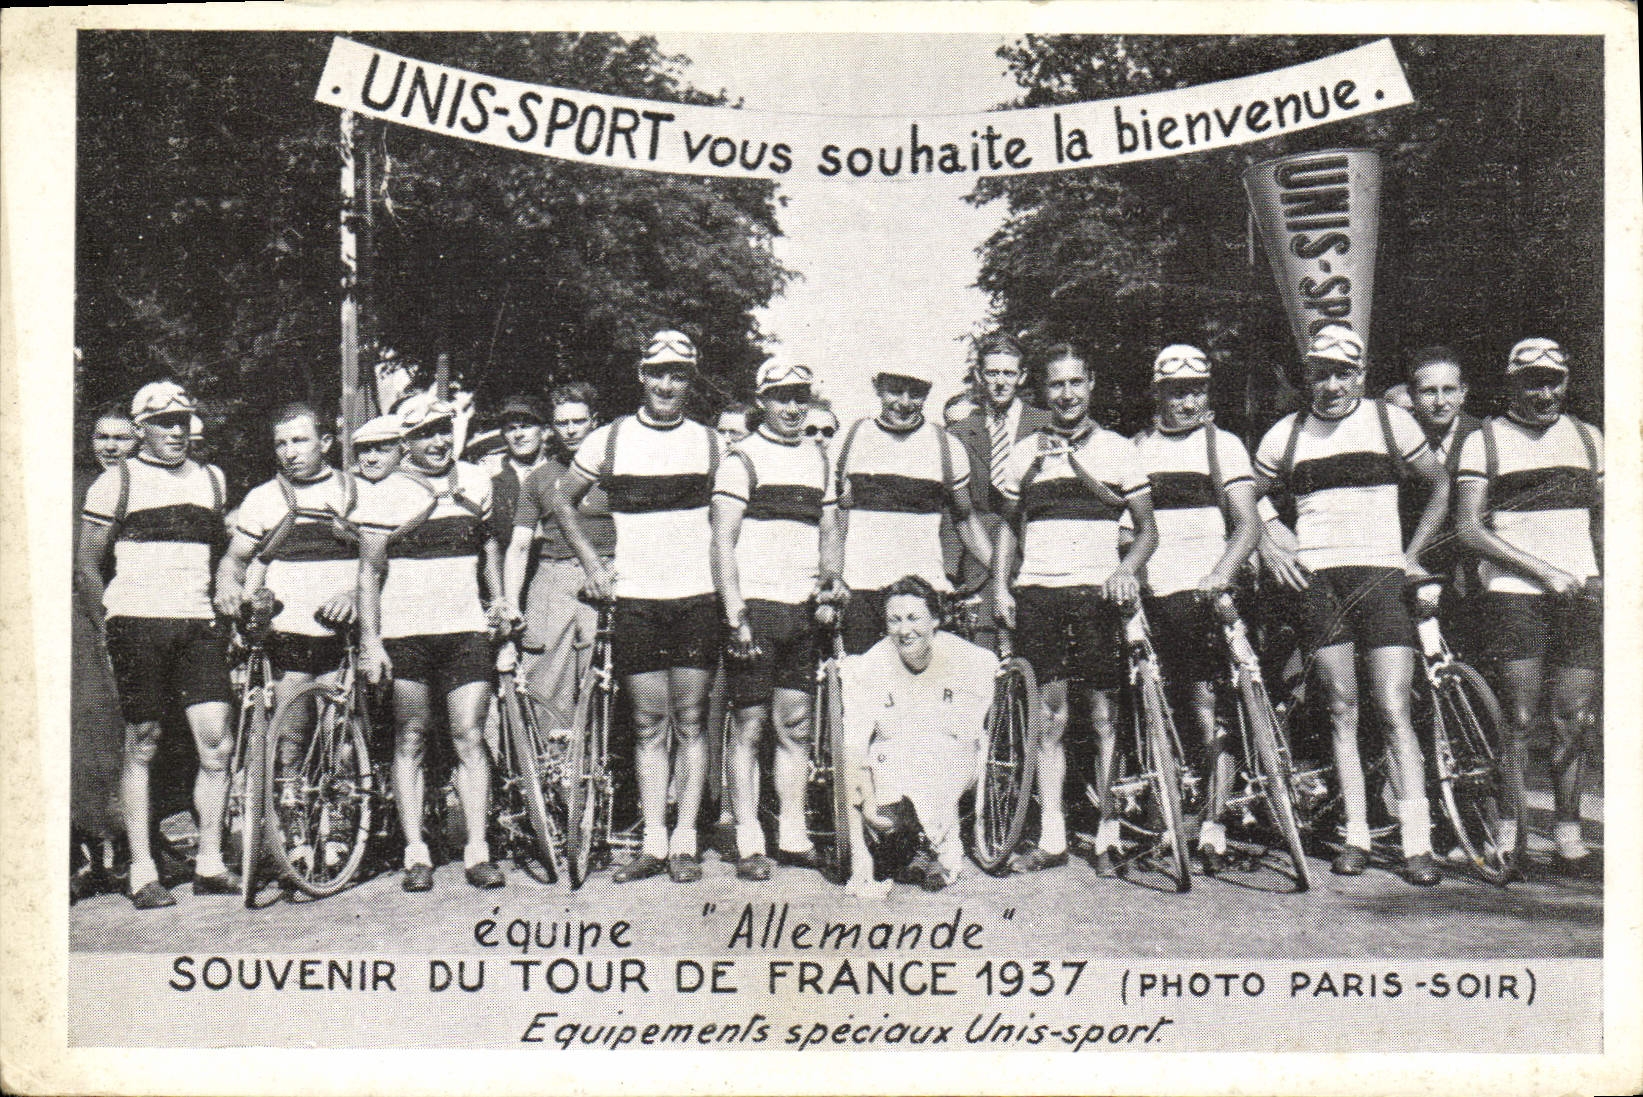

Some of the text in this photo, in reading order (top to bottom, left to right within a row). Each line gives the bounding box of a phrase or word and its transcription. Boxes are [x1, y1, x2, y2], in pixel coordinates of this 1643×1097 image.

[361, 53, 675, 162] UNIS-SPORT
[683, 130, 793, 174] vous
[817, 123, 1032, 177] souhaite
[1054, 113, 1093, 163] la
